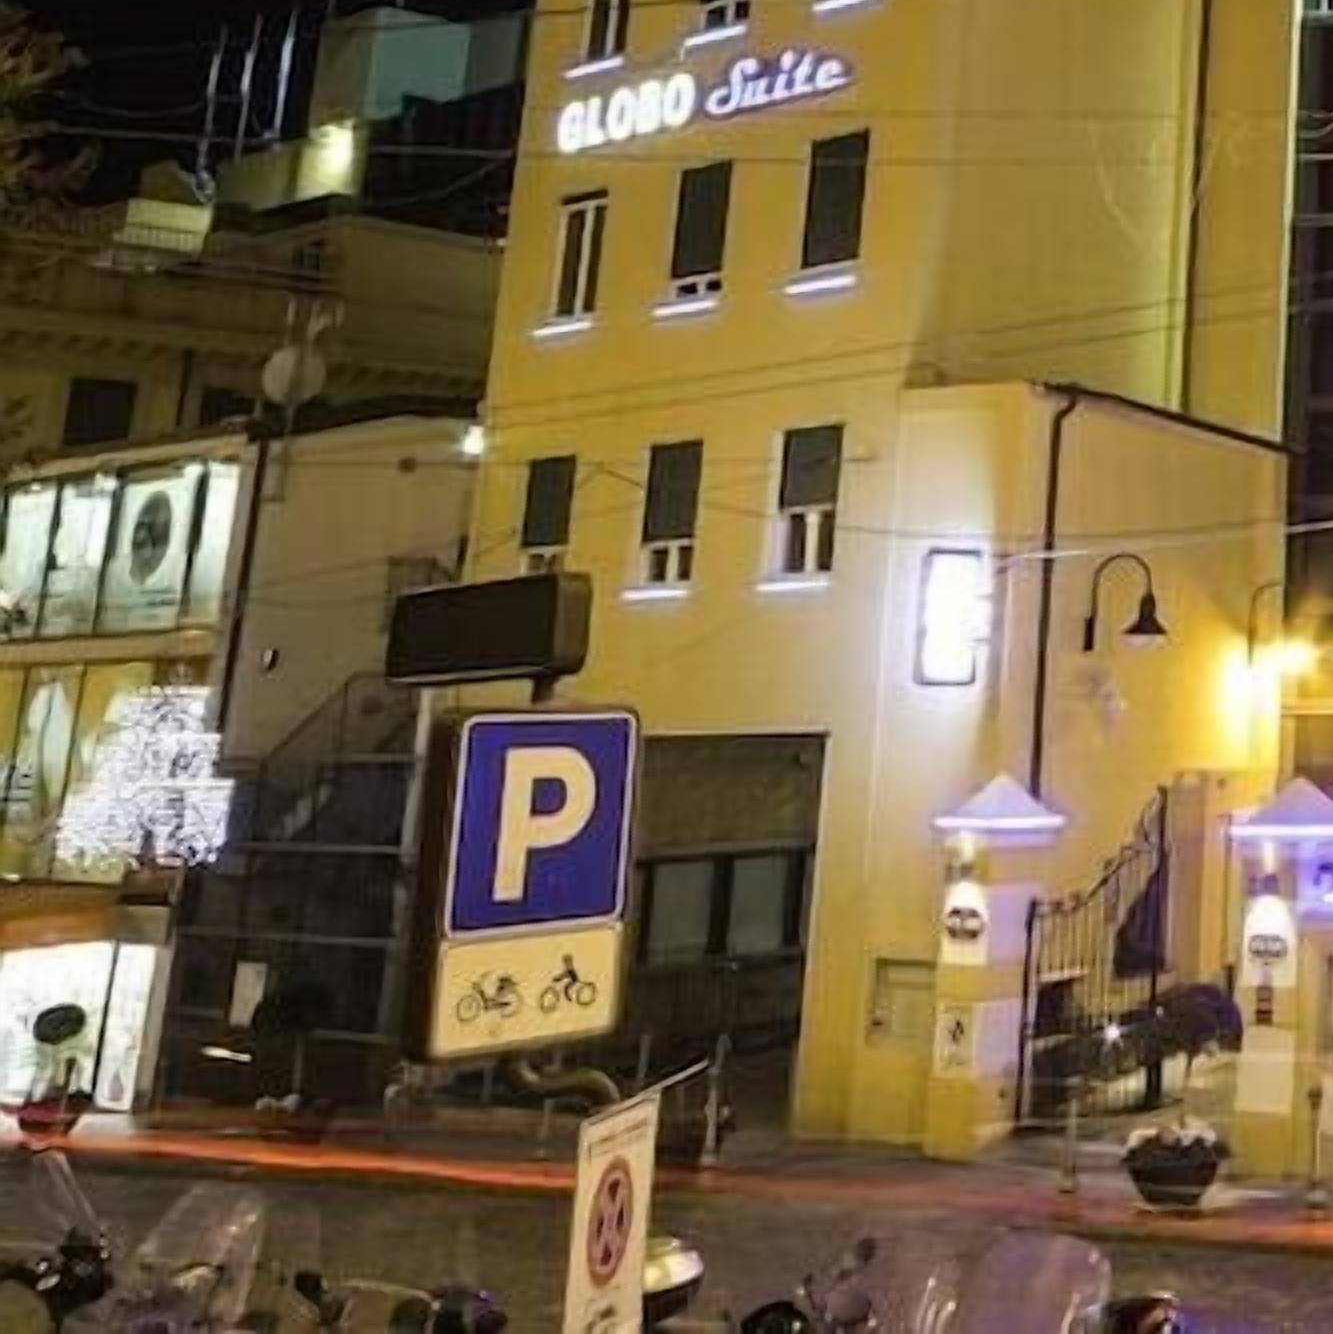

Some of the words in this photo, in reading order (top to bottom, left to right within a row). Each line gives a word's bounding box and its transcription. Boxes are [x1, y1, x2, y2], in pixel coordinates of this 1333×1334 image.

[557, 73, 696, 154] GLOBO
[704, 48, 852, 114] Suite
[492, 745, 595, 902] P
